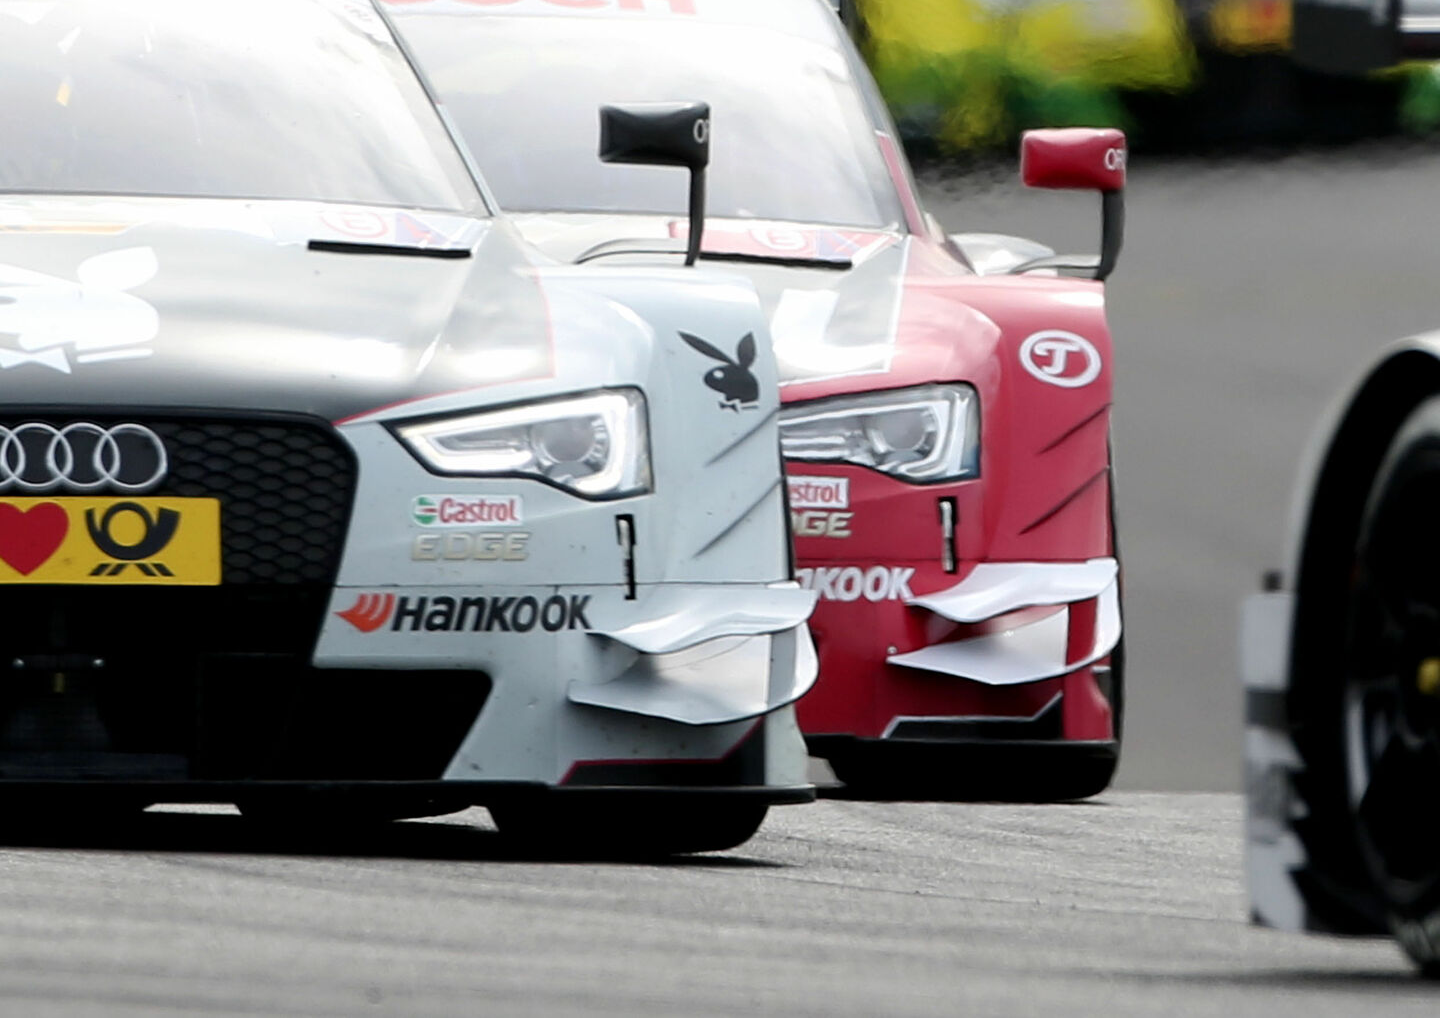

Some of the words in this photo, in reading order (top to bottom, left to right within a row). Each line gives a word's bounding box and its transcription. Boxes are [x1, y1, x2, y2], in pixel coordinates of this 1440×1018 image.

[789, 482, 843, 504] strol
[437, 497, 519, 524] Castrol
[791, 510, 855, 538] GE
[412, 531, 532, 561] EDGE
